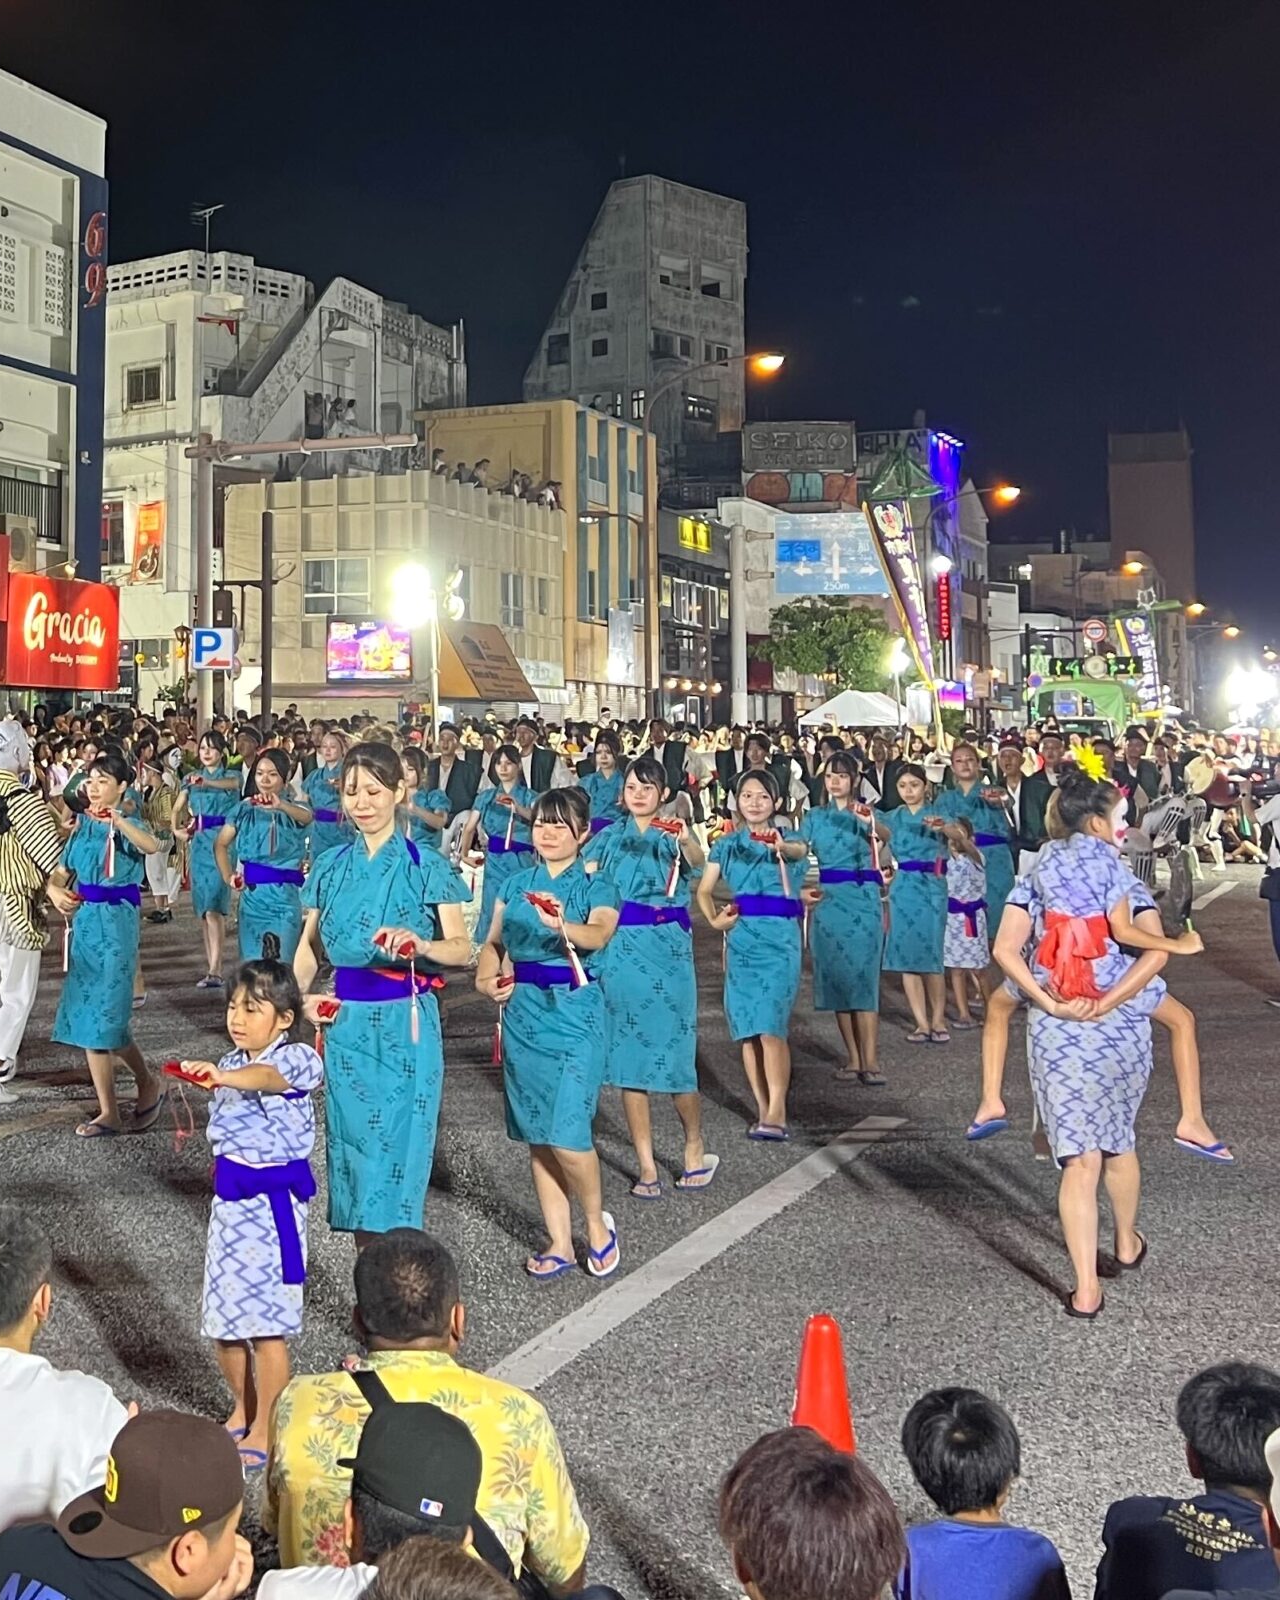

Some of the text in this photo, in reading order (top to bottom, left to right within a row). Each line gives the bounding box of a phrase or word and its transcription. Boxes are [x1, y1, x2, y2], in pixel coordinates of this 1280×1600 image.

[750, 431, 849, 451] SEIKO
[823, 582, 851, 592] 250m
[23, 591, 107, 651] Gracia
[194, 630, 222, 663] P
